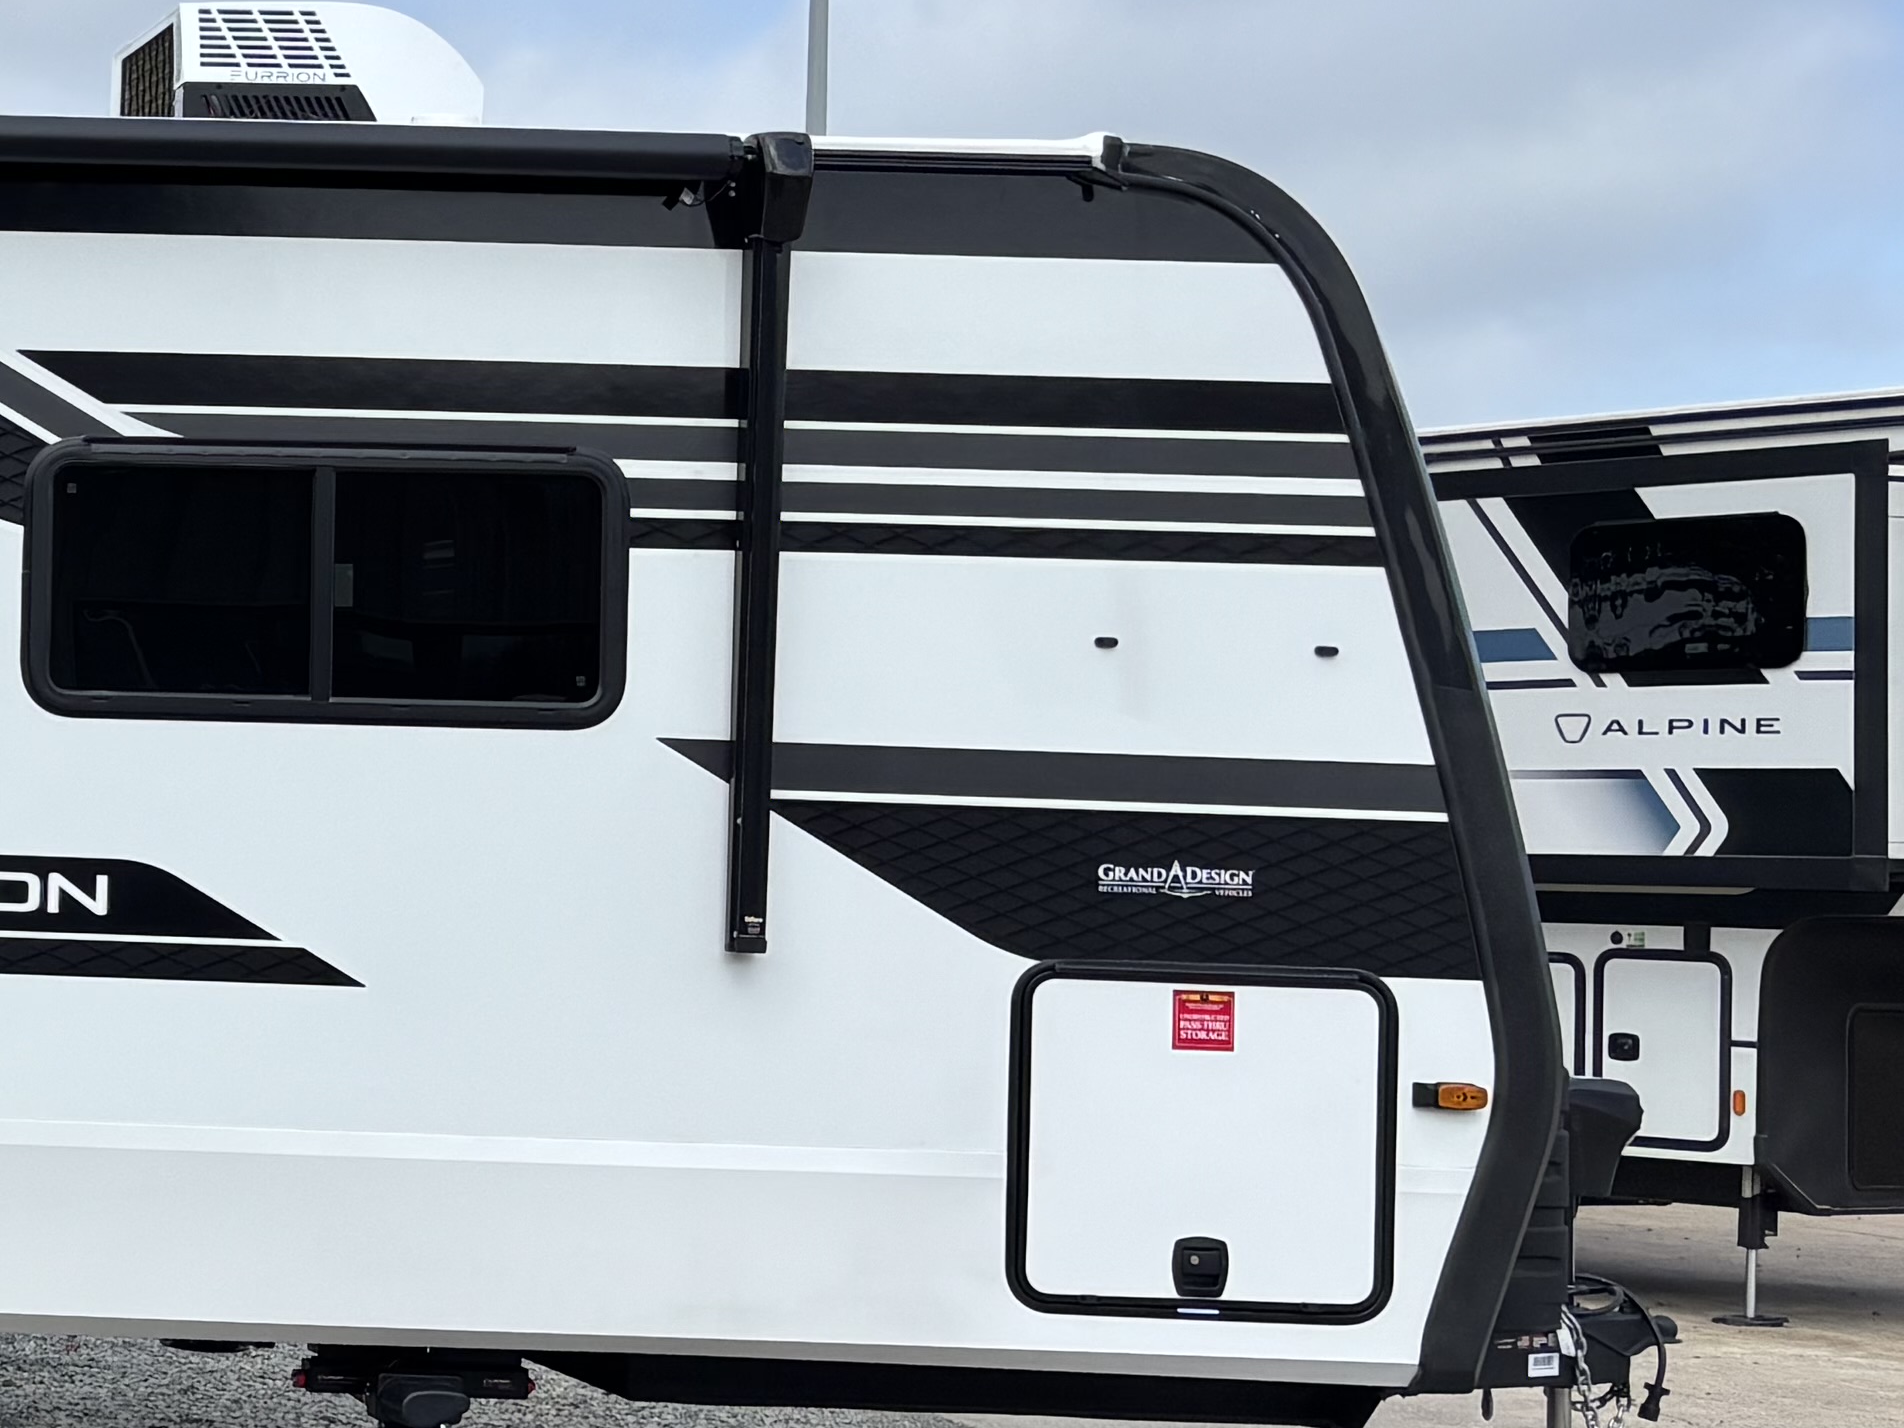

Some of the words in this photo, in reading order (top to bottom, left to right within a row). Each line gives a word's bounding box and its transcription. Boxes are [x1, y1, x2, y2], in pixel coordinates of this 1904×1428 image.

[229, 70, 326, 83] FURRION
[1601, 717, 1781, 736] ALPINE
[1097, 863, 1167, 883] GRAND
[1185, 866, 1254, 885] DESIGN
[1179, 1029, 1230, 1041] STORAGE
